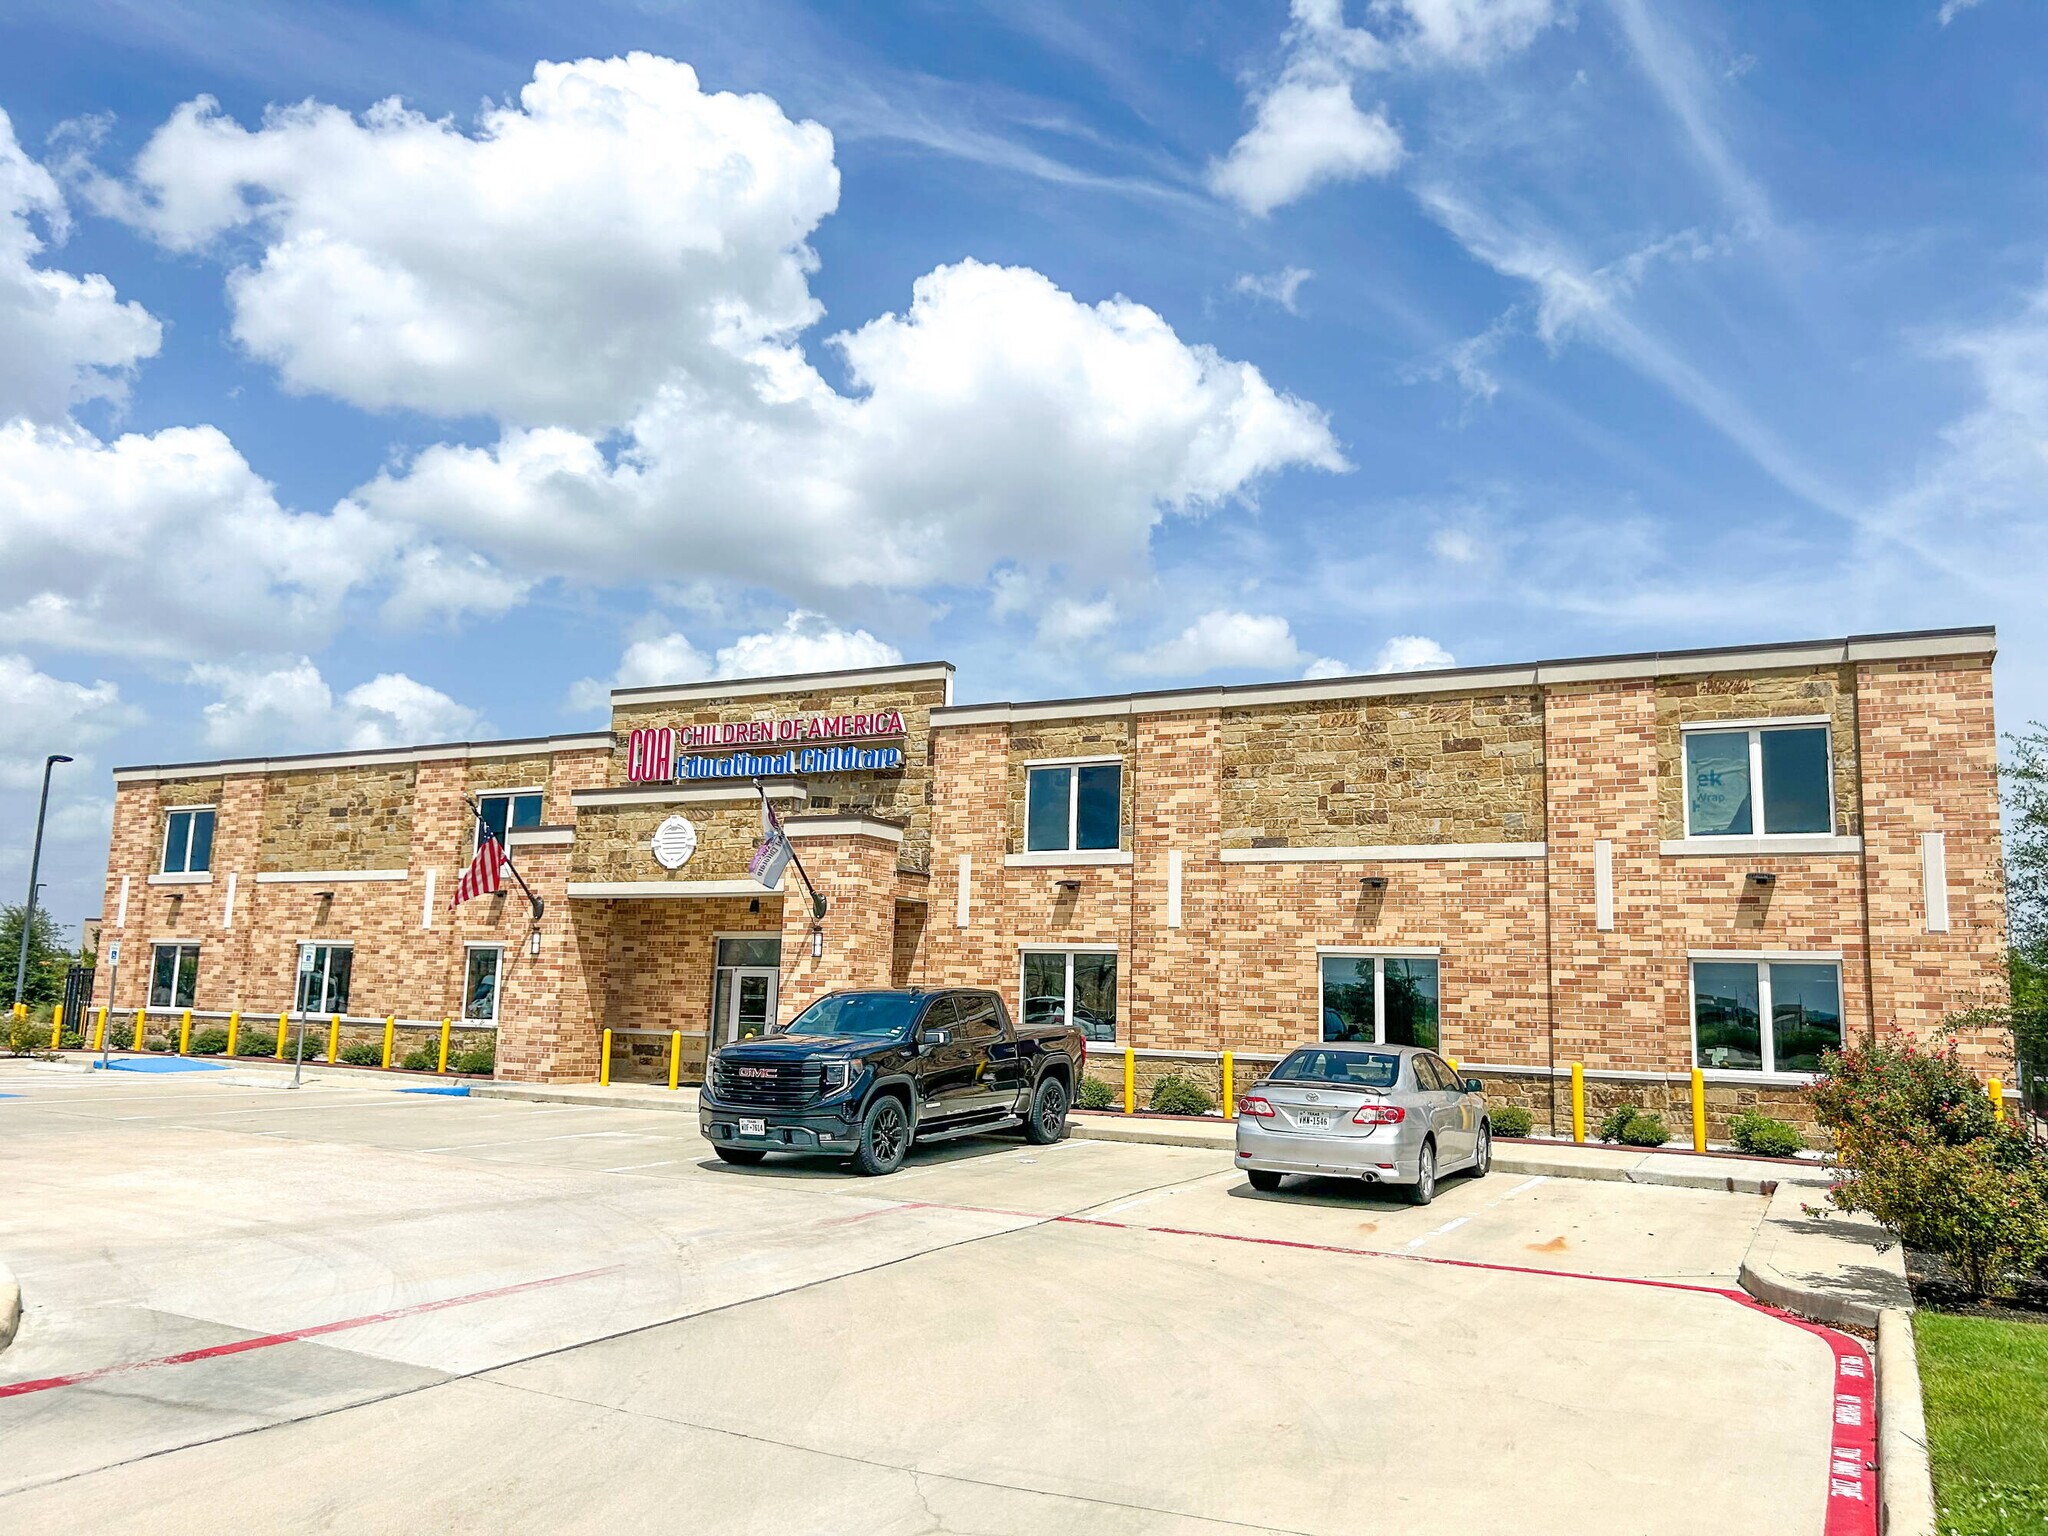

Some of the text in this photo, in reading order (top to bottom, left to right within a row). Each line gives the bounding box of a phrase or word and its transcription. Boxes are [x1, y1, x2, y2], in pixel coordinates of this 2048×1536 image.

[680, 711, 904, 746] CHILDREN OF AMERICA
[627, 727, 674, 782] COA
[677, 745, 901, 779] Educational Childcare
[739, 1067, 778, 1078] GMC
